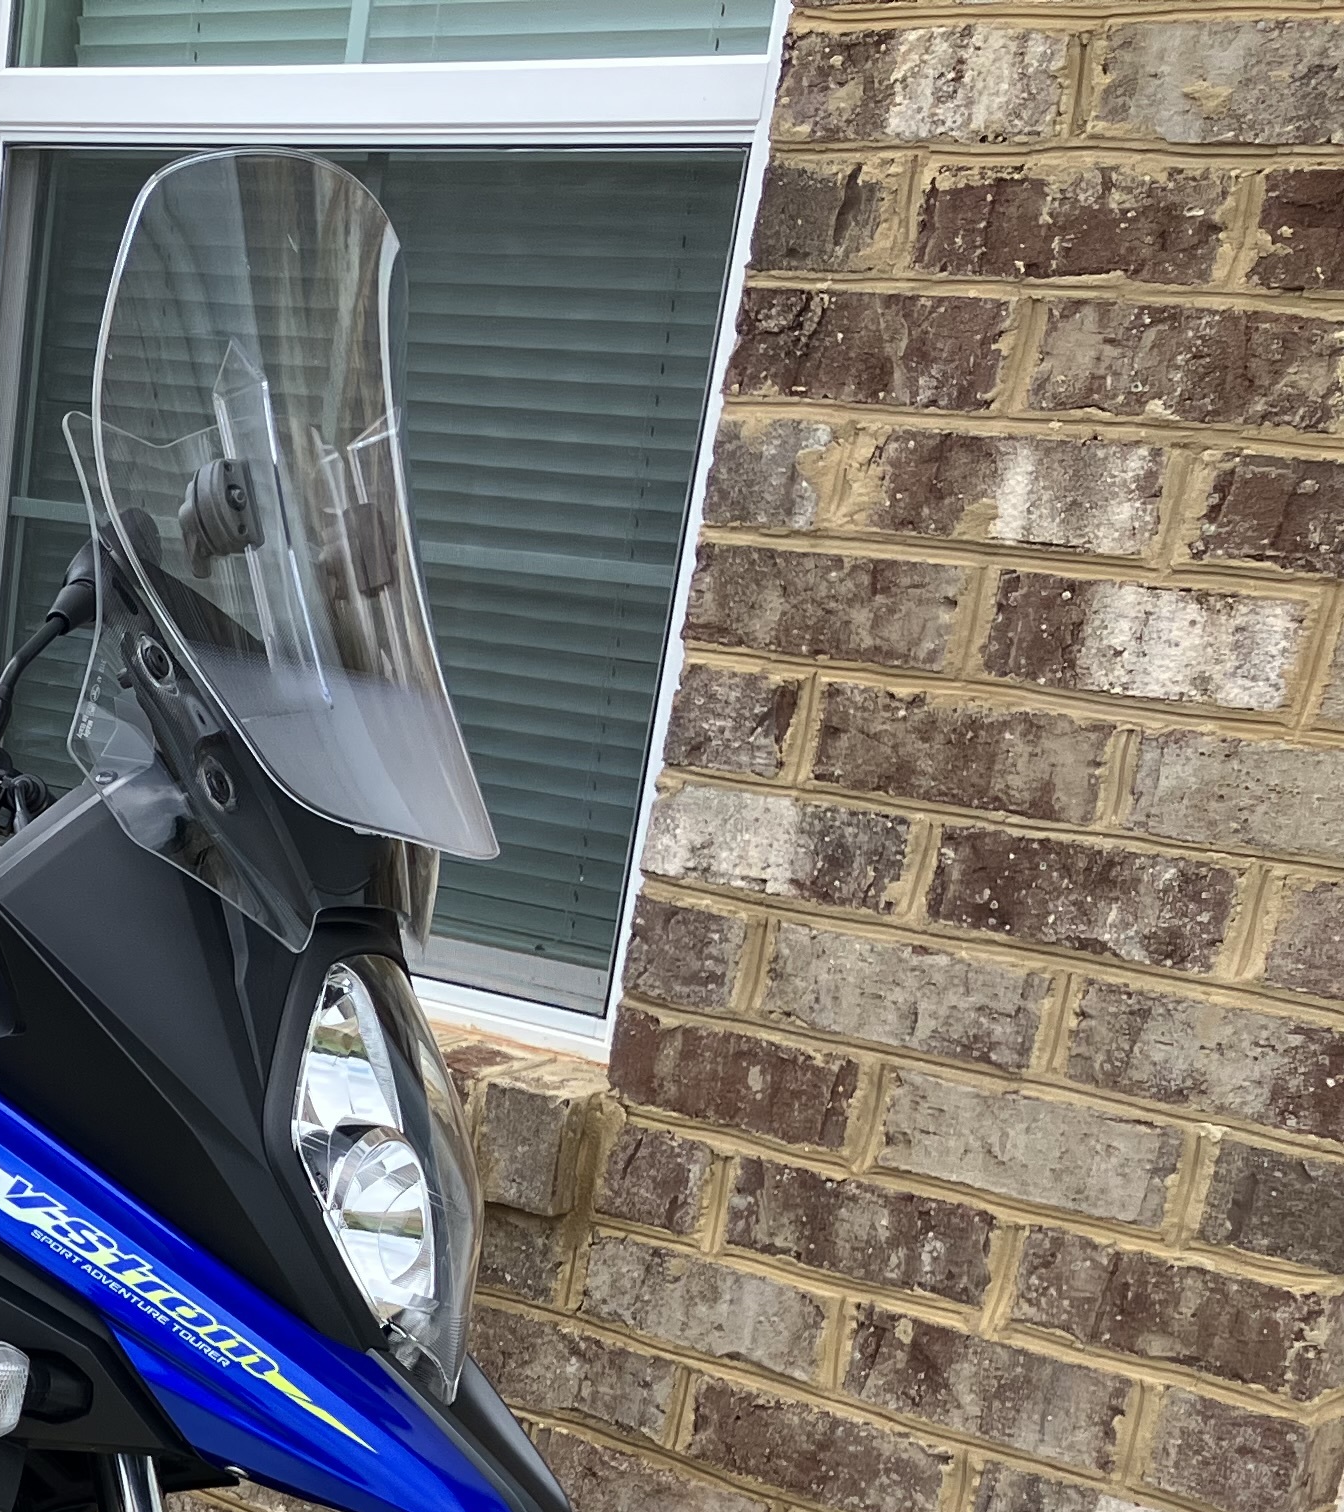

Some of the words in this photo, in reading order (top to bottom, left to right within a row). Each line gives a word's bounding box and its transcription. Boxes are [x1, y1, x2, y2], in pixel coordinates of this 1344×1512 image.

[30, 1228, 83, 1264] SPORT
[80, 1261, 172, 1327] ADVENTURE
[171, 1321, 232, 1369] TOURER
